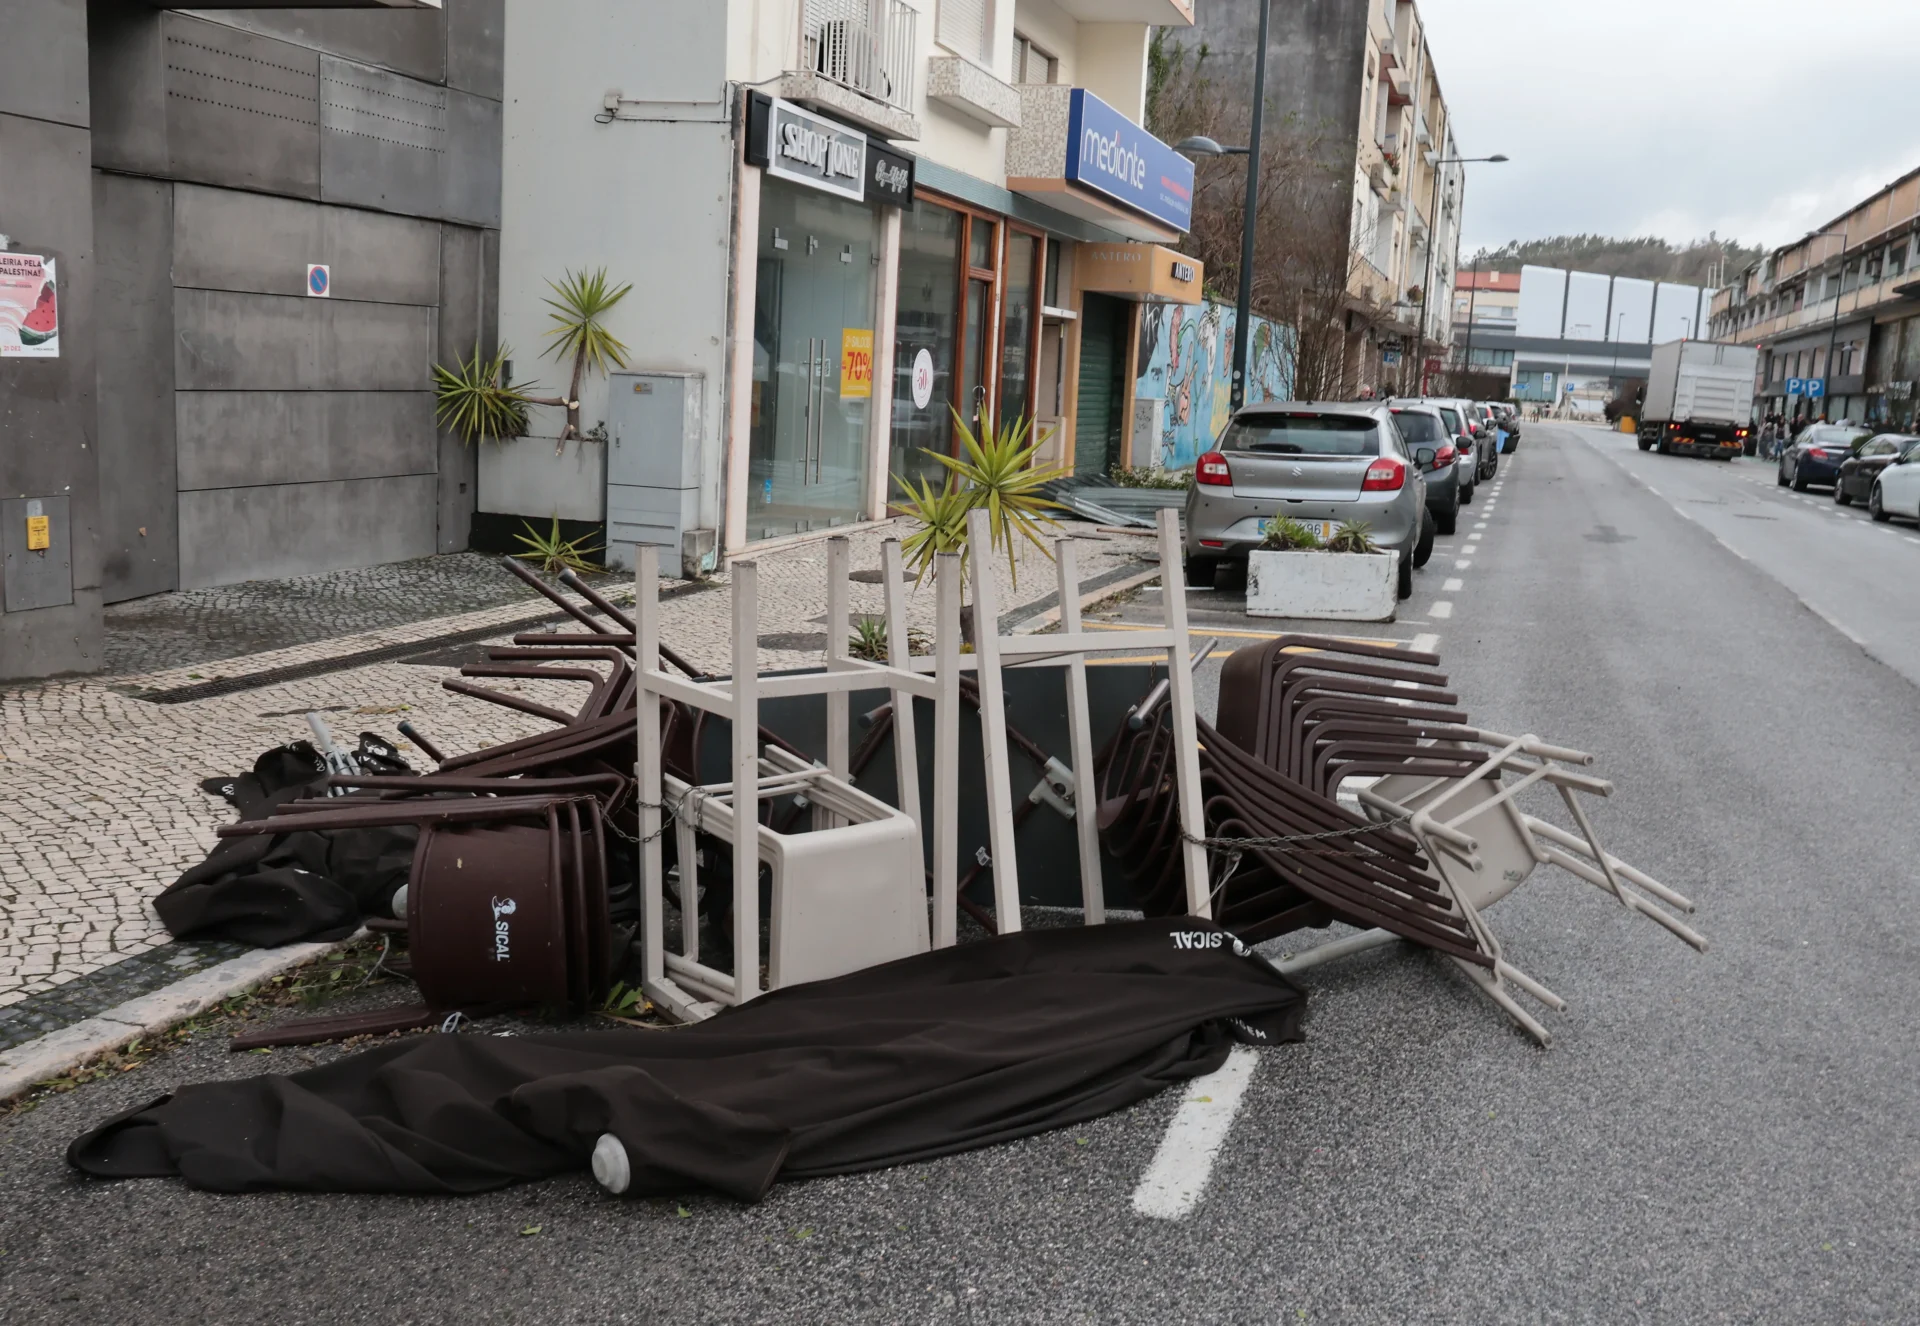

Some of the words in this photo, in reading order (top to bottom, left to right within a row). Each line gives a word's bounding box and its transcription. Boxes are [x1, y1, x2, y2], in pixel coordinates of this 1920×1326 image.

[1083, 127, 1146, 190] mediante
[24, 259, 42, 268] PELA
[1092, 251, 1142, 263] ANTERO
[0, 267, 41, 277] PALESTINA!
[1174, 261, 1196, 283] ANTERO
[1788, 378, 1801, 393] P
[1808, 380, 1820, 397] P
[495, 920, 510, 962] SICAL
[1169, 931, 1224, 950] SICAL
